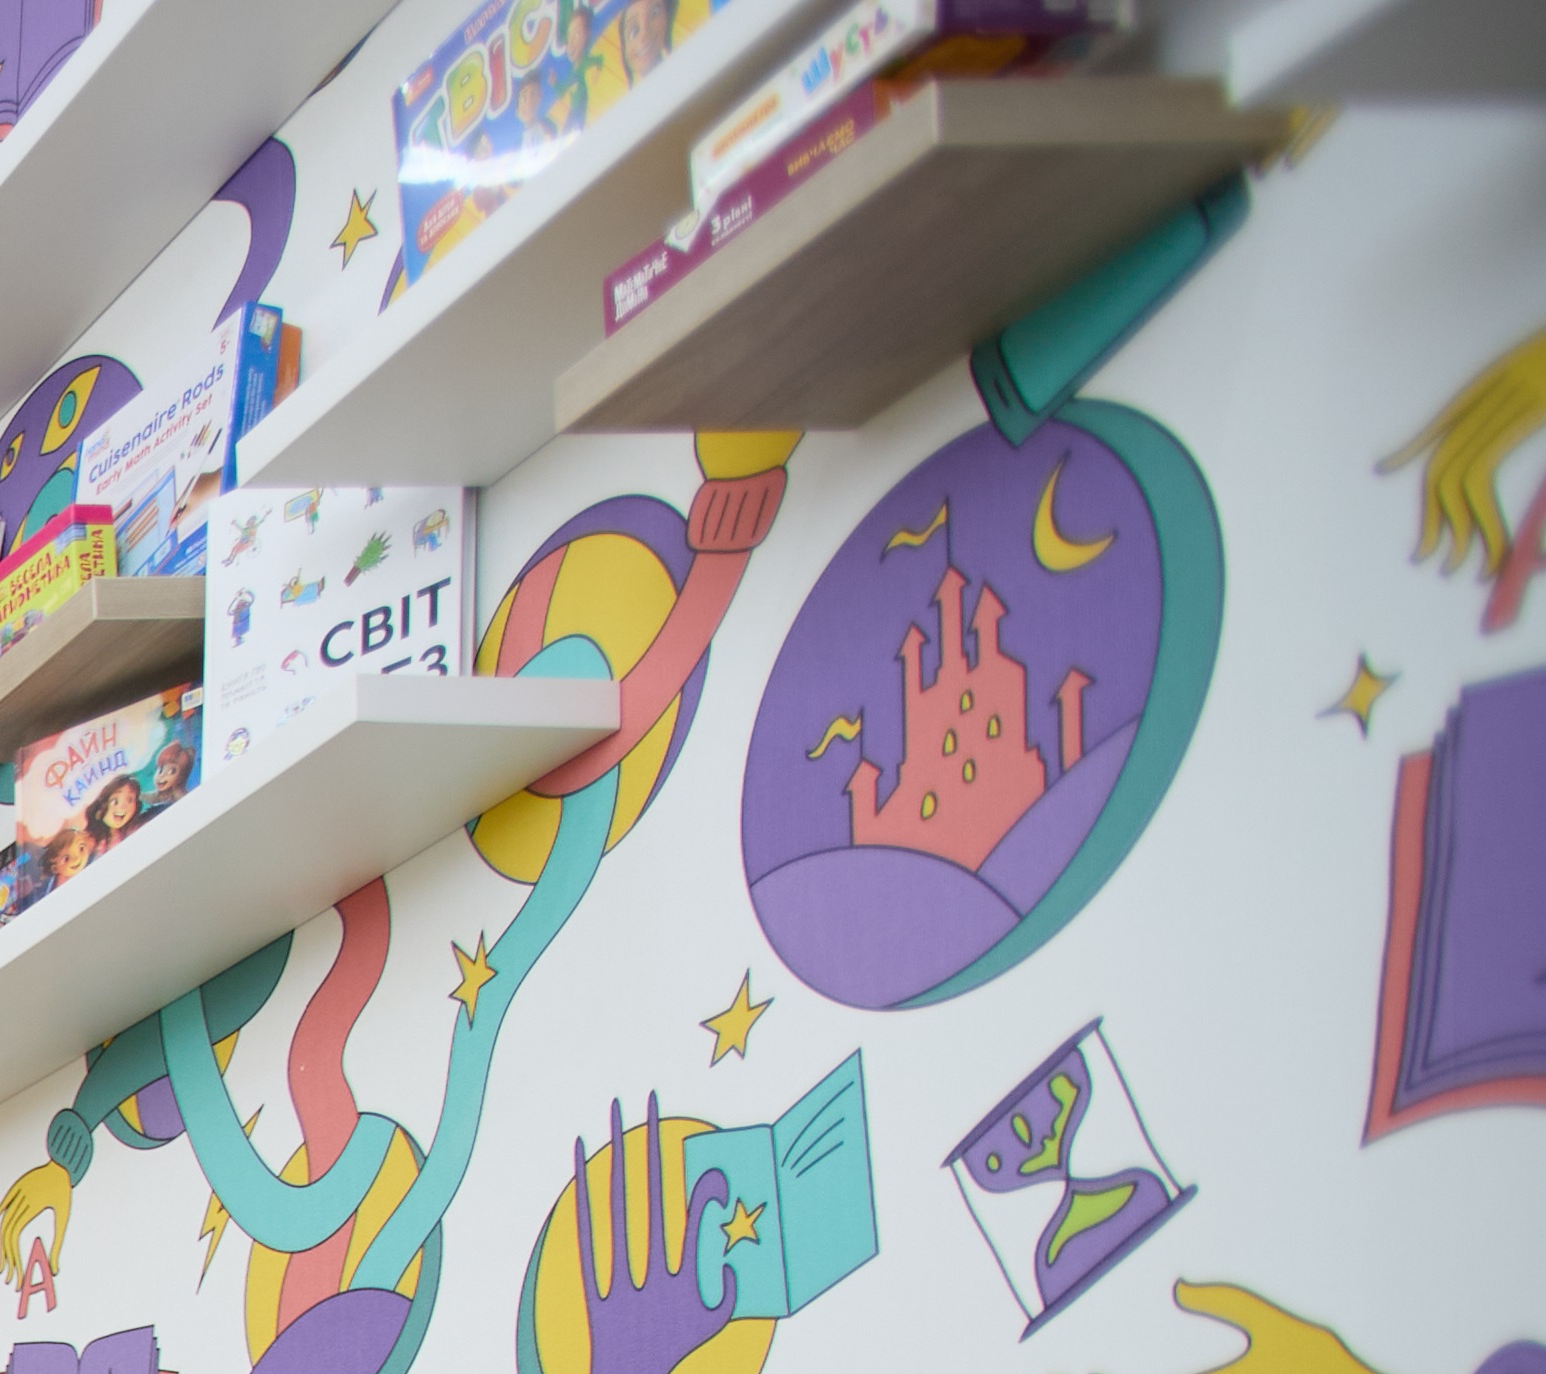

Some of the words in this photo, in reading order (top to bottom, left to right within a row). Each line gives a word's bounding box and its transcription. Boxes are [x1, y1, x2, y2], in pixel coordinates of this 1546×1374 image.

[181, 363, 225, 410] Rods
[95, 464, 122, 496] Early
[124, 442, 152, 472] Math
[153, 411, 193, 447] Activity
[195, 394, 213, 415] Set
[319, 576, 452, 668] СВІТ
[44, 722, 117, 790] ФАЙН
[62, 749, 129, 808] КАЙНД
